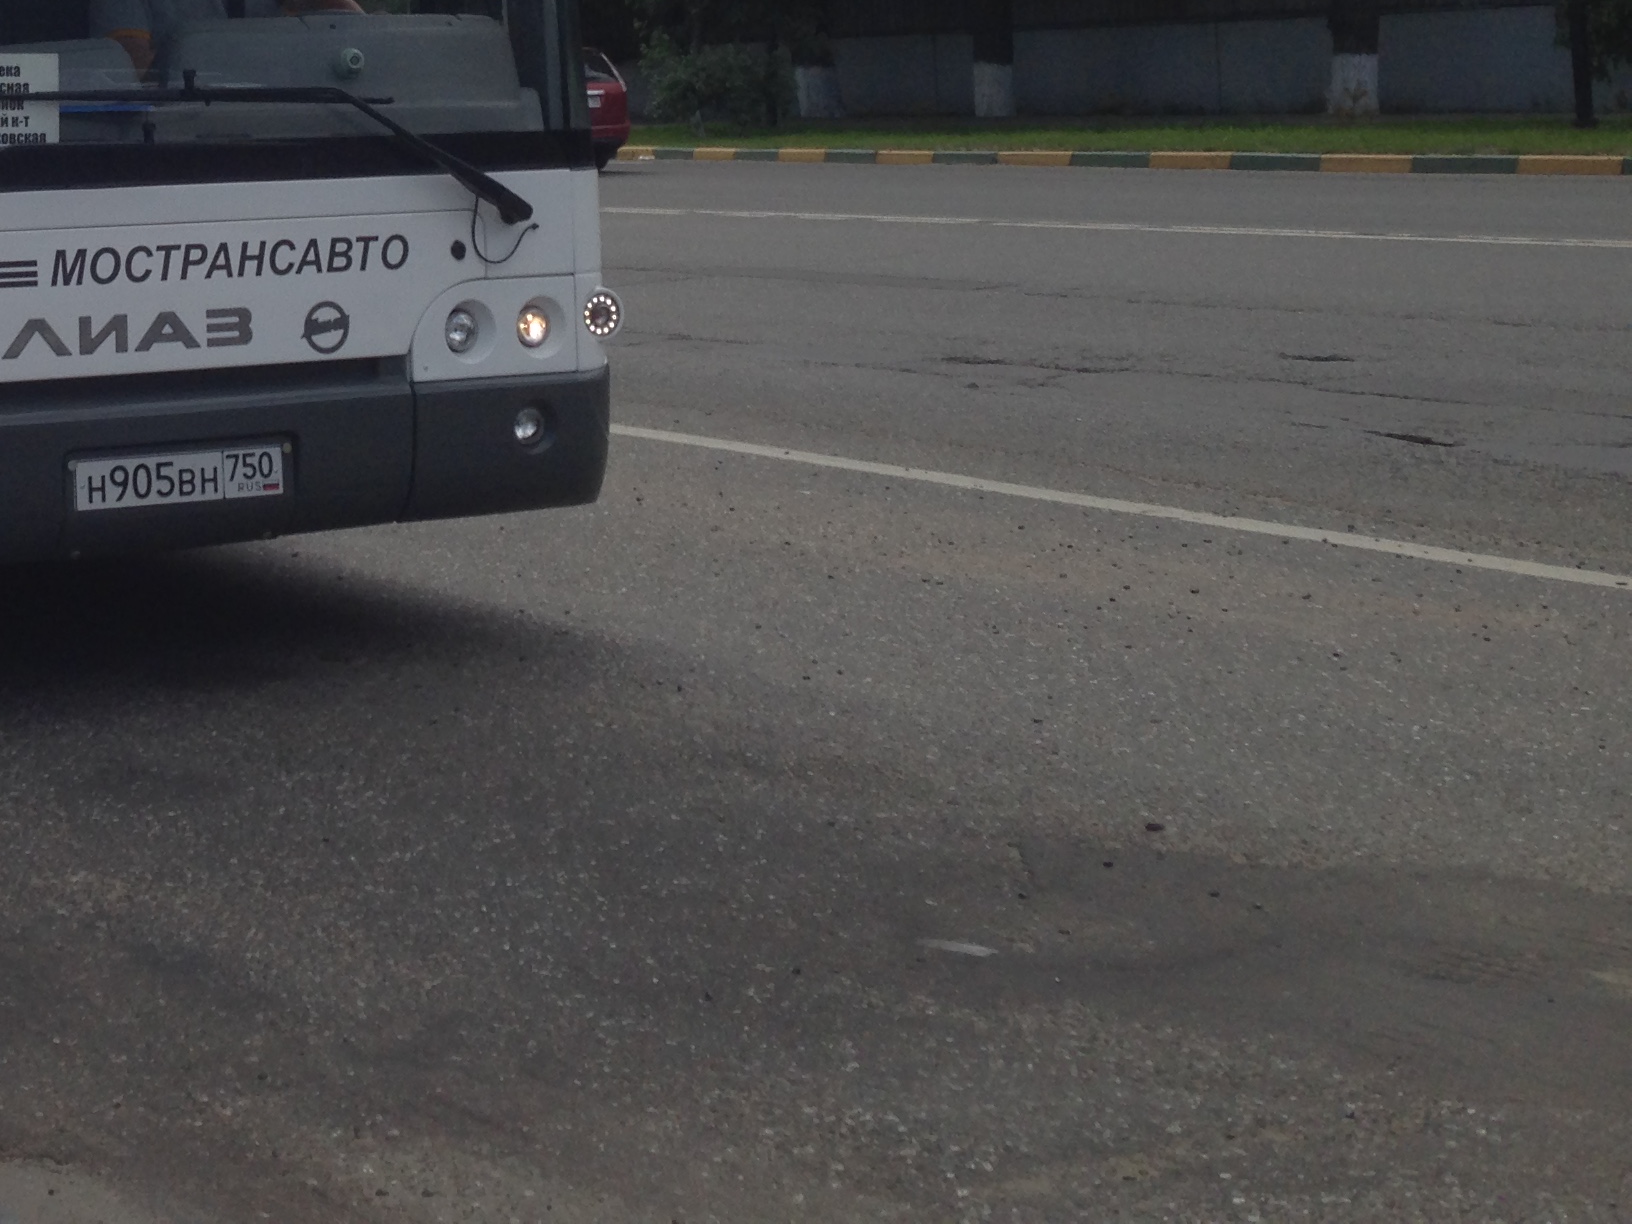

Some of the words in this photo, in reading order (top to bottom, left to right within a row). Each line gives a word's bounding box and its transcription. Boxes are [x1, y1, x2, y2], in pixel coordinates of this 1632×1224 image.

[51, 234, 410, 287] МОСТРАНСАВТО
[2, 307, 253, 360] ЛИАЗ
[226, 451, 273, 482] 750
[237, 482, 262, 492] RUS
